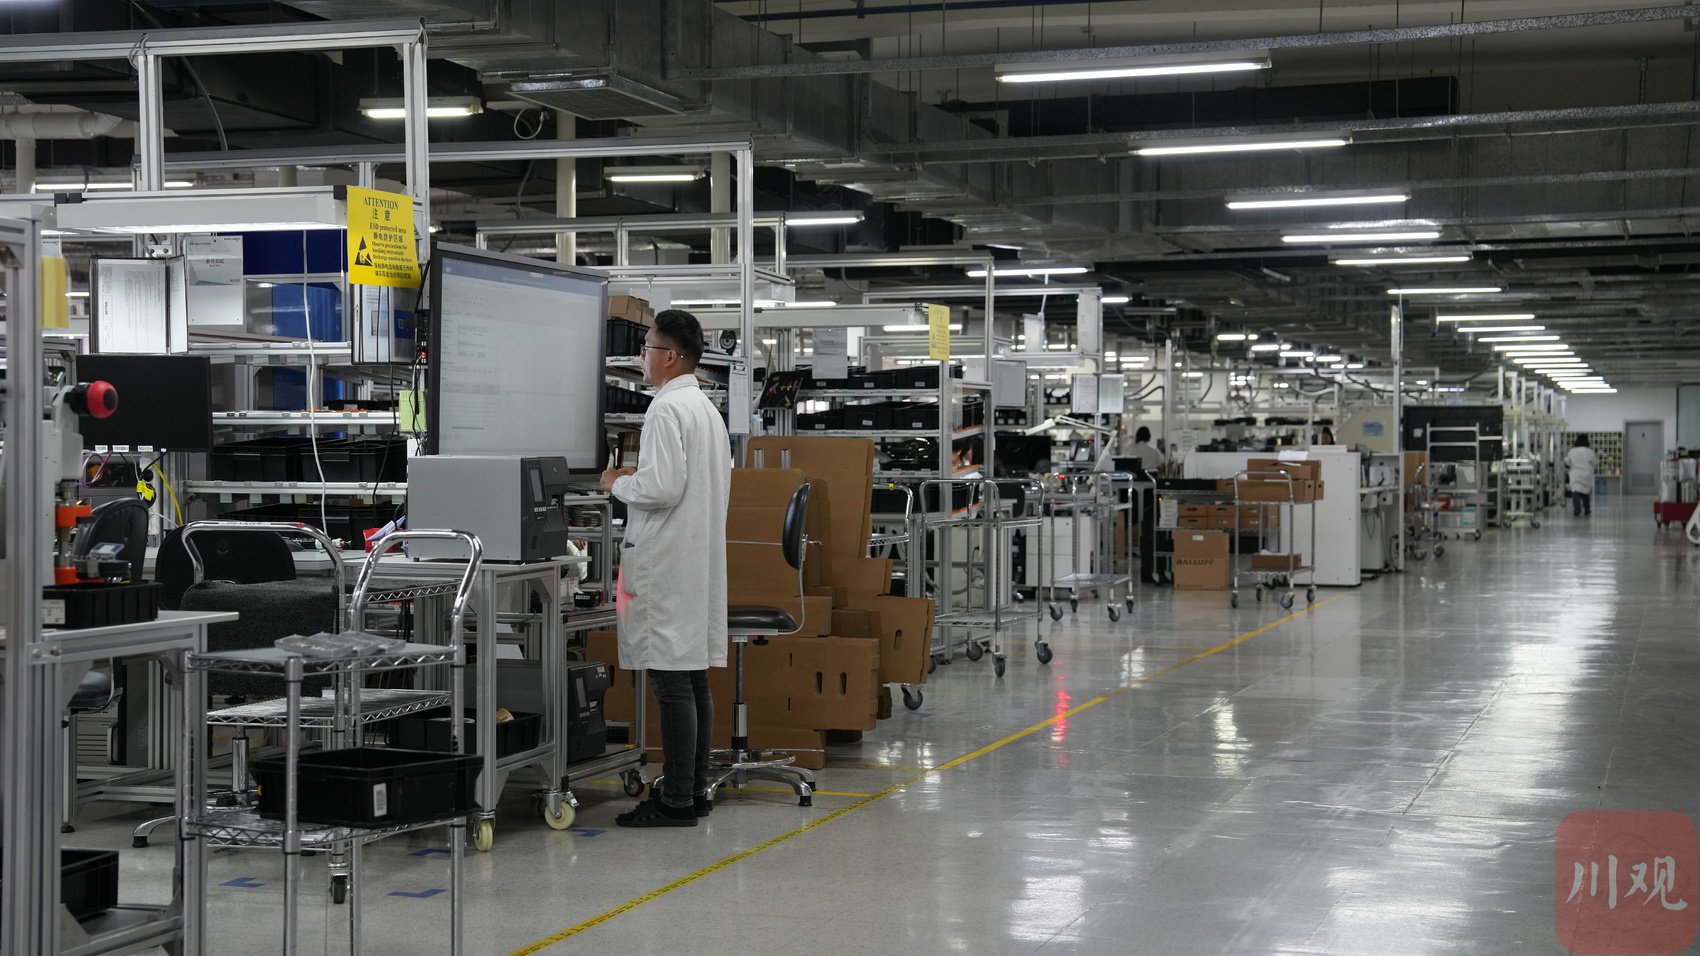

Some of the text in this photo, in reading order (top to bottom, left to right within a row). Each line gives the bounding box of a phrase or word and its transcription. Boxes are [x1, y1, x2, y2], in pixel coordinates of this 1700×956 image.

[364, 197, 399, 210] ATTENTION
[372, 208, 391, 221] 注意
[370, 222, 379, 230] ESD
[380, 225, 398, 233] protected
